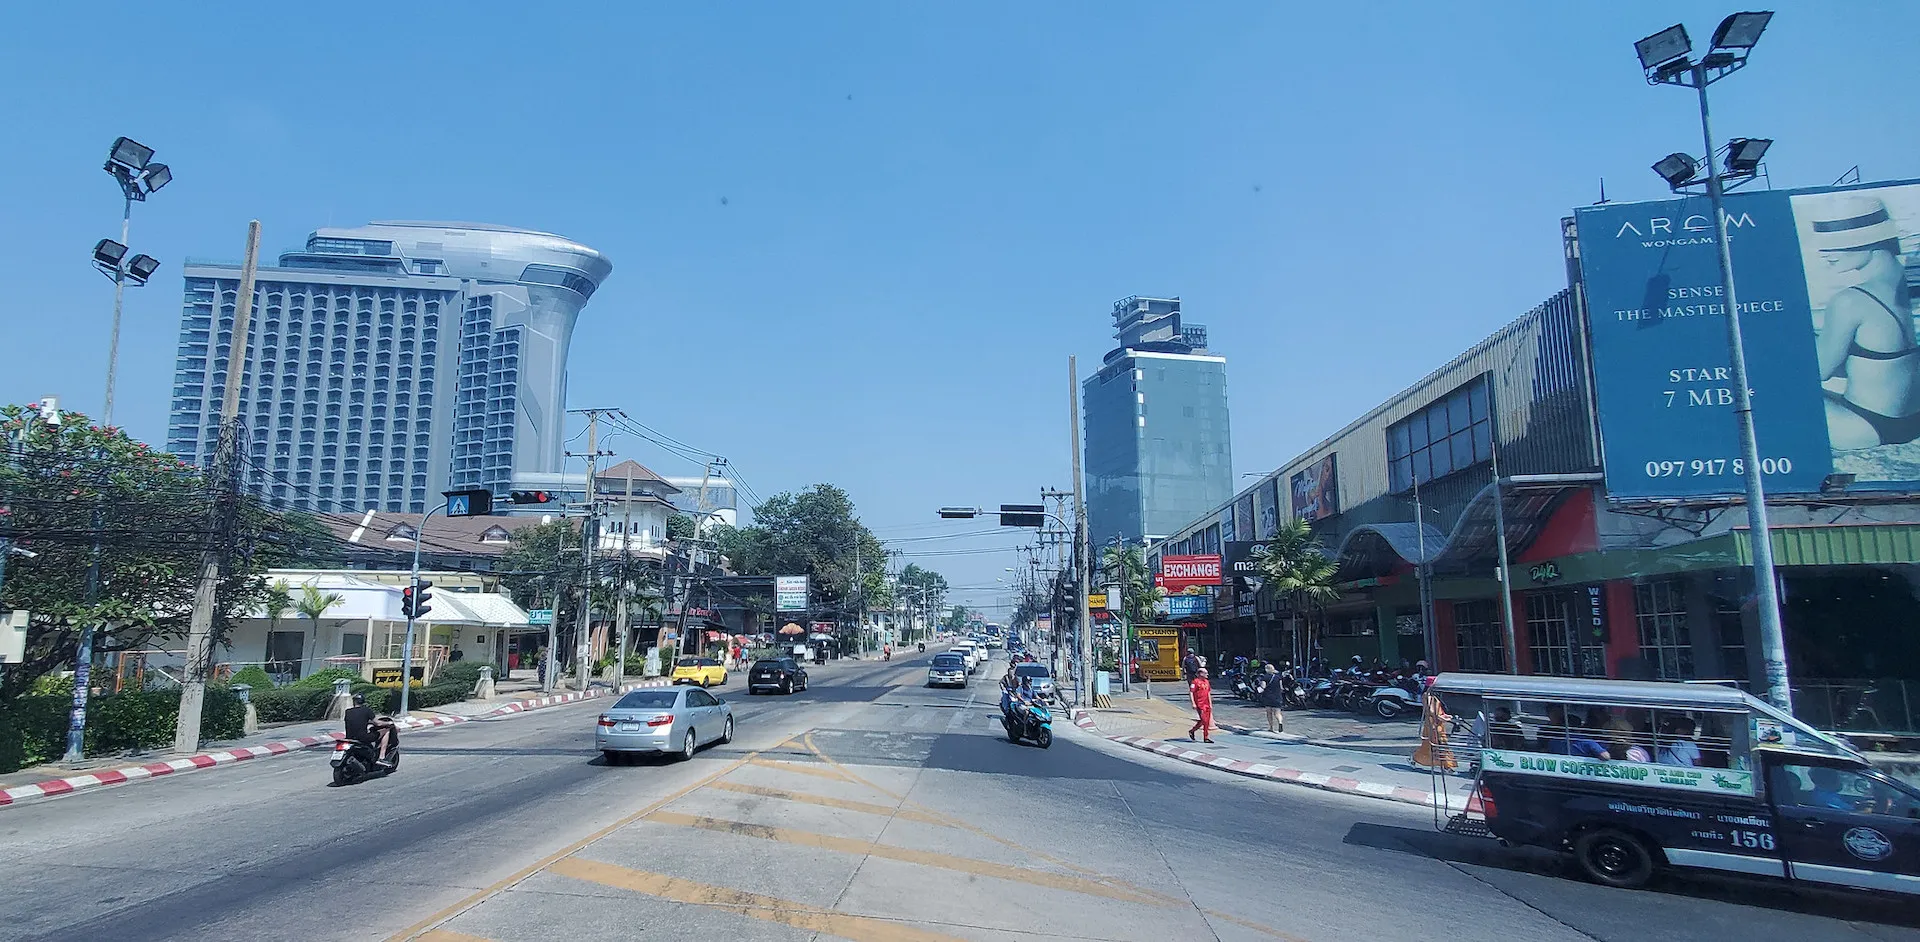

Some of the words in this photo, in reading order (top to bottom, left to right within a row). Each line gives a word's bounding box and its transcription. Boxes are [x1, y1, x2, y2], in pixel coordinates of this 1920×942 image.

[1641, 235, 1734, 248] WONGAMT
[1668, 285, 1724, 299] SENSE
[1614, 309, 1652, 321] THE
[1658, 300, 1784, 318] MASTEPIECE
[1669, 367, 1732, 383] STAR
[1663, 391, 1676, 408] 7
[1645, 461, 1685, 478] 097
[1690, 459, 1726, 476] 917
[1732, 457, 1792, 476] 800
[1163, 563, 1220, 578] EXCHANGE
[1171, 597, 1206, 608] Indian
[1588, 587, 1602, 626] WEED
[1519, 756, 1557, 773] BLOW
[1559, 758, 1649, 781] COFFEESHOP
[1729, 829, 1775, 851] 156
